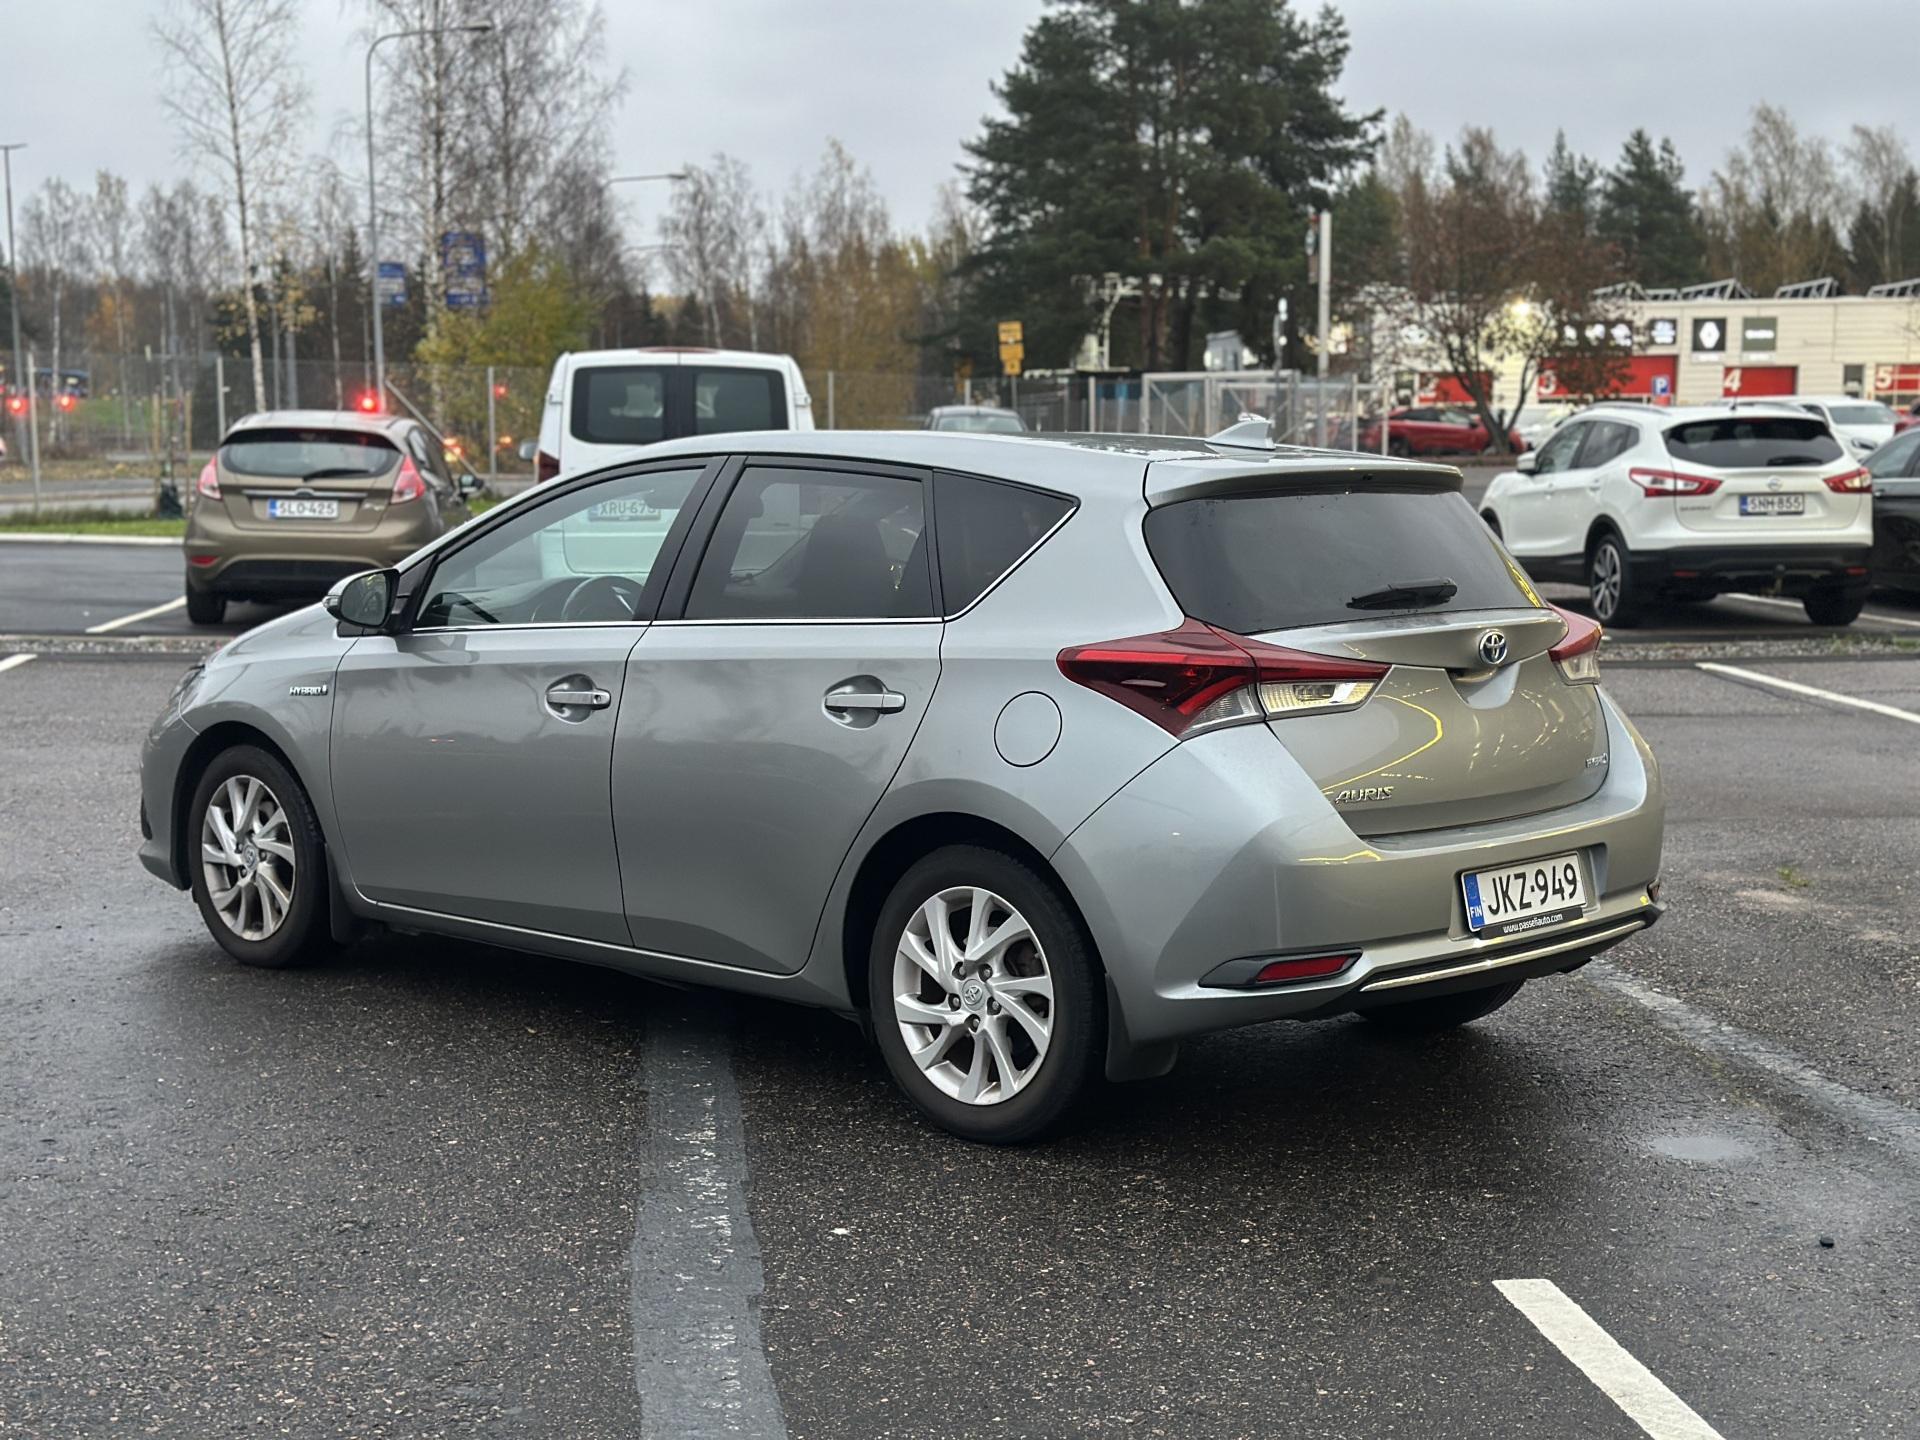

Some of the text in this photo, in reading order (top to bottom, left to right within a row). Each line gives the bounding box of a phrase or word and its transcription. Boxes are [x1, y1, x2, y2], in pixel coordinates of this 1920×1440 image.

[1655, 378, 1668, 394] P
[1724, 368, 1741, 392] 4
[1876, 366, 1892, 389] 5
[280, 502, 335, 514] SLO-425
[1335, 786, 1394, 803] AURIS
[1488, 863, 1577, 915] JKZ-949
[1470, 904, 1483, 918] FIN
[1503, 913, 1563, 933] www.passeliauto.com
